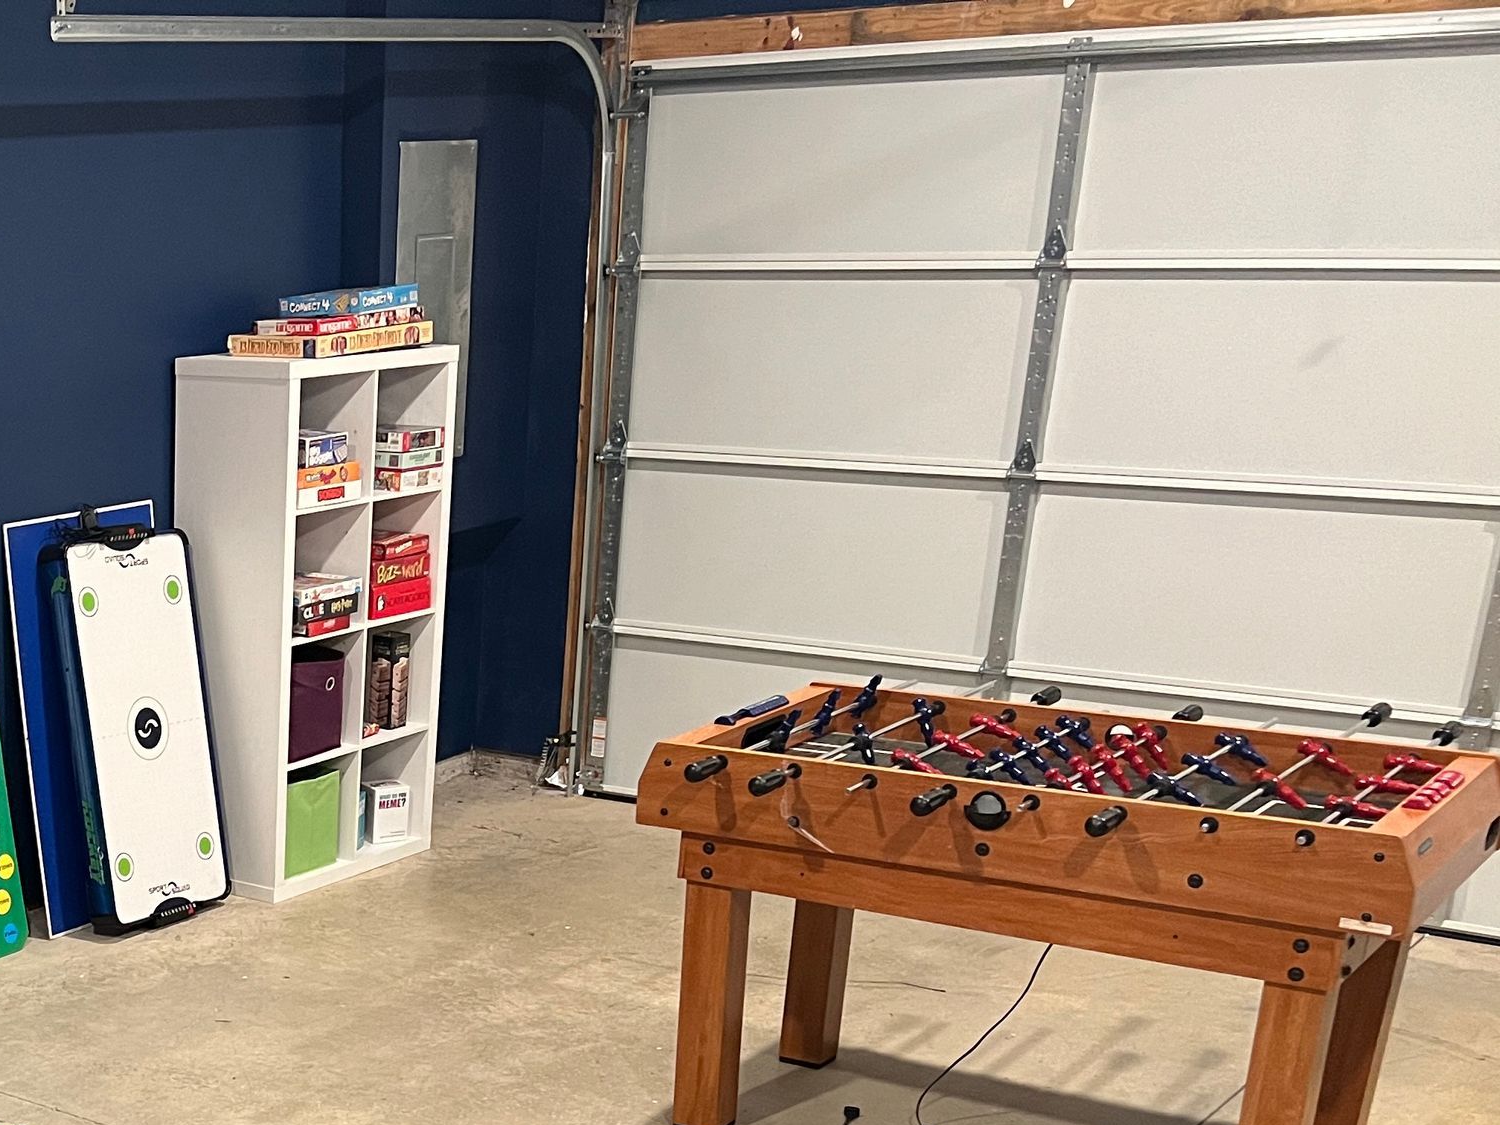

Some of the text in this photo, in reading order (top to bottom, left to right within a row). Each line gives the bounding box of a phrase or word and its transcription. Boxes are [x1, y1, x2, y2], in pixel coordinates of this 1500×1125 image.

[386, 292, 393, 303] 4
[289, 299, 330, 313] CONNECT 4
[303, 603, 324, 619] CLUE
[379, 798, 406, 809] MEME?
